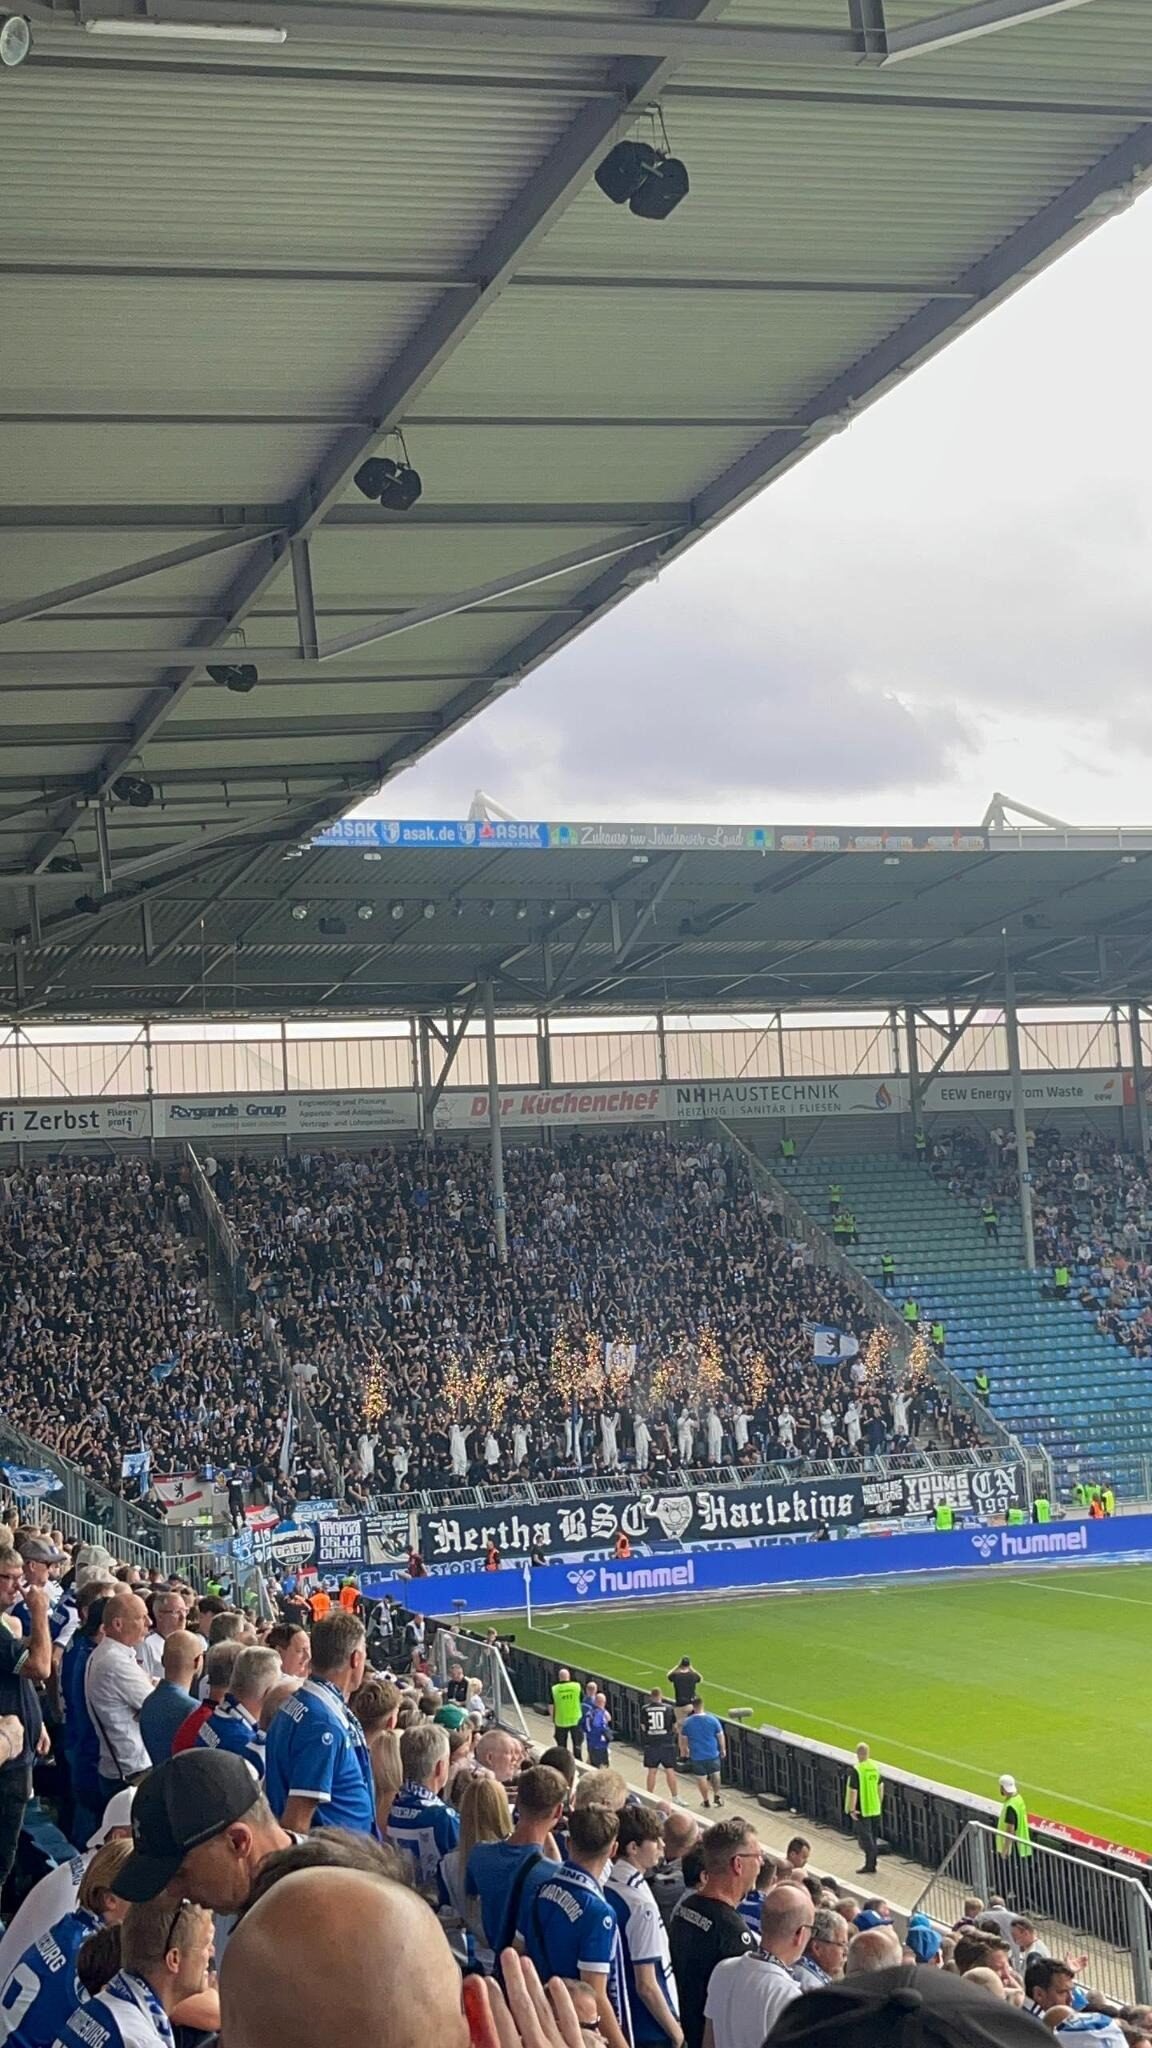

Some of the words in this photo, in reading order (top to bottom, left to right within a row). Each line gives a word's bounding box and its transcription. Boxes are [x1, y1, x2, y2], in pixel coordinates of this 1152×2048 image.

[332, 822, 378, 838] ASAK
[403, 825, 456, 841] asak.de
[496, 824, 541, 840] ASAK
[581, 826, 630, 846] Zuhause
[630, 828, 647, 846] im
[708, 827, 744, 847] Land
[470, 1096, 514, 1117] Dr
[521, 1088, 660, 1115] Küchenchef
[940, 1088, 968, 1101] EEW
[970, 1087, 1012, 1102] Energy
[1021, 1087, 1044, 1099] rom
[1046, 1085, 1084, 1098] Waste
[107, 1108, 139, 1117] Fliesen
[246, 1103, 287, 1118] Group
[677, 1106, 727, 1117] HEIZUNG
[799, 1103, 842, 1113] FLIESEN
[23, 1109, 100, 1131] Zerbst
[107, 1117, 133, 1132] profi
[905, 1472, 969, 1496] YOUNG
[428, 1514, 552, 1556] Hertha
[556, 1502, 650, 1543] BSC
[699, 1489, 855, 1532] Harlekins
[1001, 1525, 1088, 1556] hummel
[600, 1559, 695, 1593] hummel
[647, 1711, 665, 1730] 30
